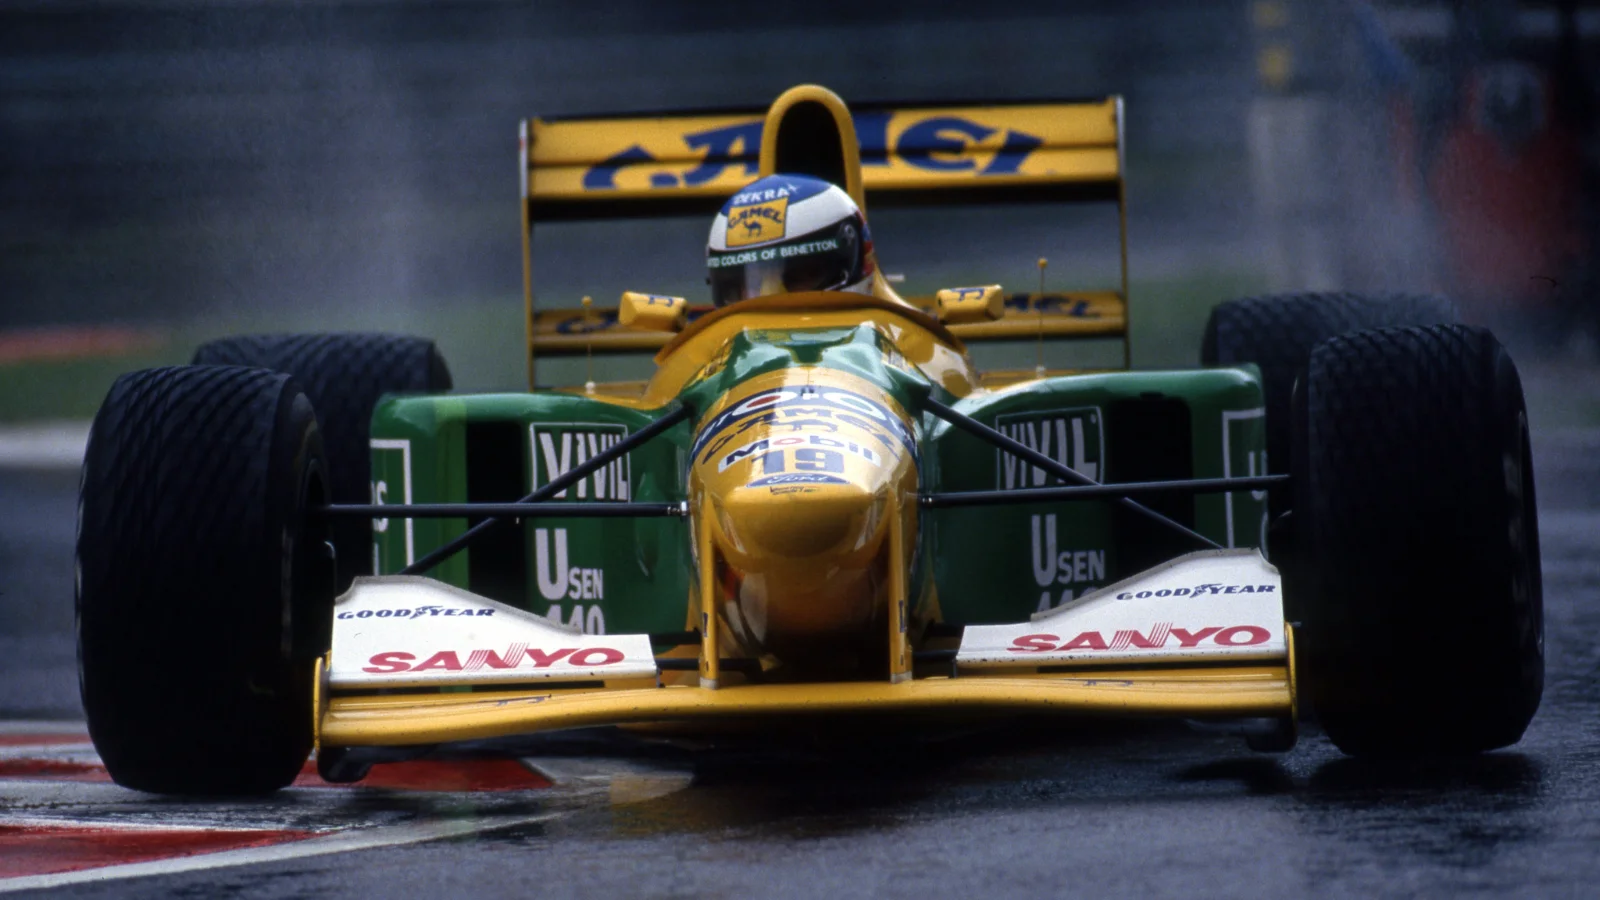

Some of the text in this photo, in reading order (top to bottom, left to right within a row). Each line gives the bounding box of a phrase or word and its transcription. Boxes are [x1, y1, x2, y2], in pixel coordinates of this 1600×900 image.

[728, 206, 782, 229] CAMEL
[721, 251, 757, 267] COLORS
[761, 249, 776, 261] OF
[726, 434, 873, 466] Mobil
[751, 448, 844, 474] 19
[1000, 417, 1097, 491] VIVIL
[538, 432, 628, 500] VIVIL
[766, 473, 829, 485] Ford
[1116, 584, 1276, 600] GOODYEAR
[337, 605, 496, 620] GOODYEAR
[1006, 622, 1272, 653] SANYO
[362, 642, 625, 674] SANYO
